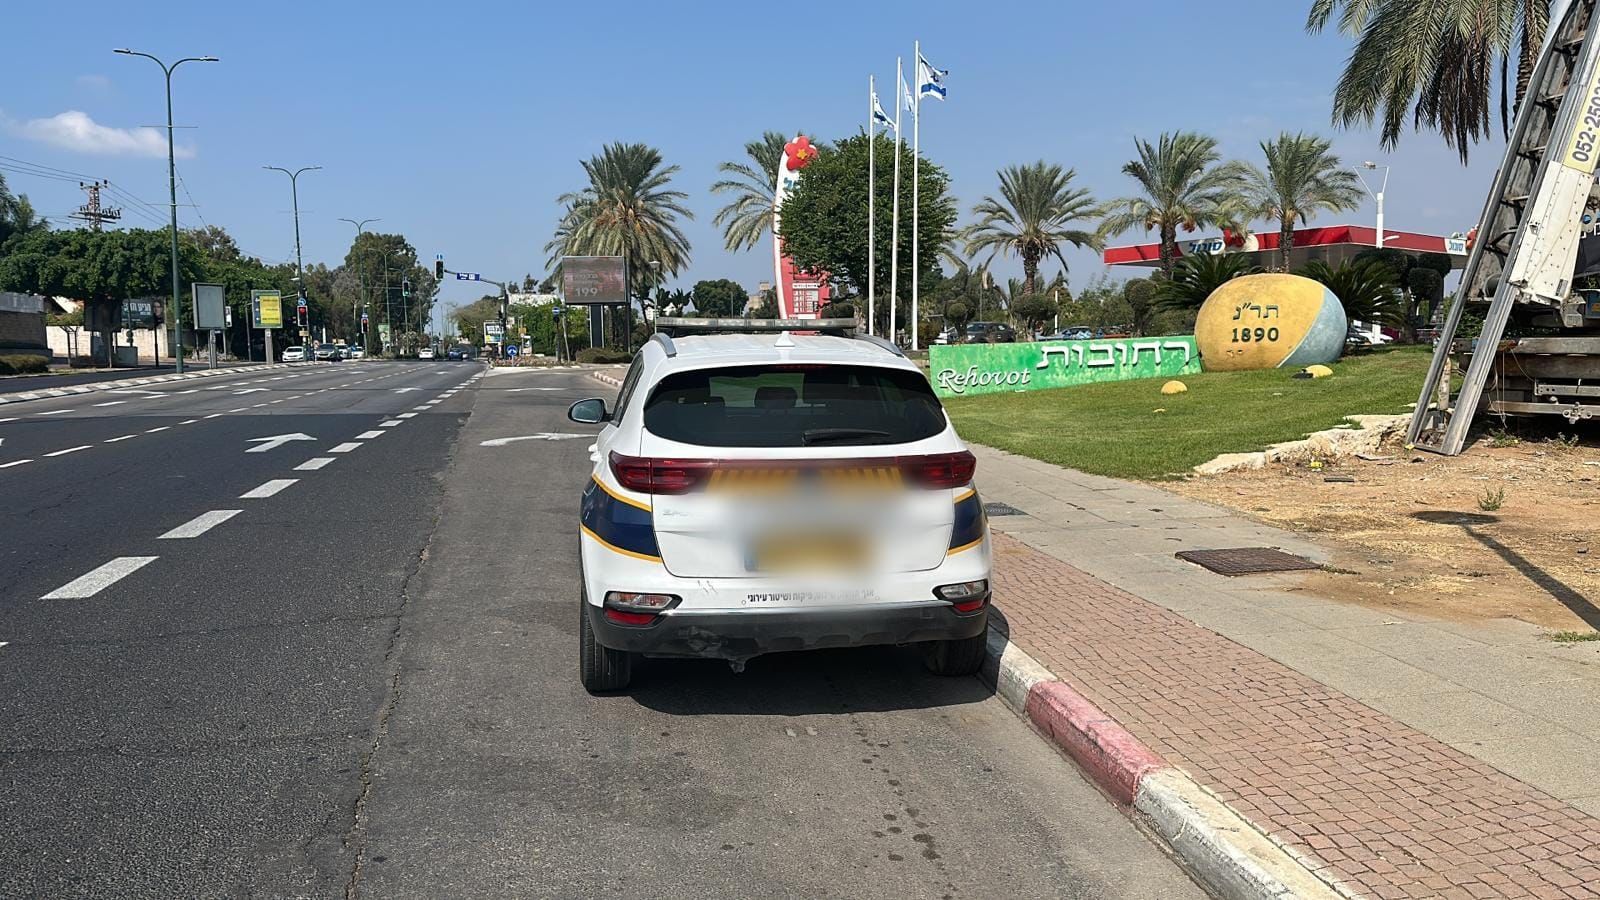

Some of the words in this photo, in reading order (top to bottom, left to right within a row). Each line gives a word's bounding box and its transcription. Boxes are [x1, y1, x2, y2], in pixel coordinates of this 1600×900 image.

[1232, 327, 1279, 343] 1890
[1036, 339, 1191, 370] רחובות
[937, 364, 1031, 394] Rehovot
[747, 593, 767, 603] עירוני
